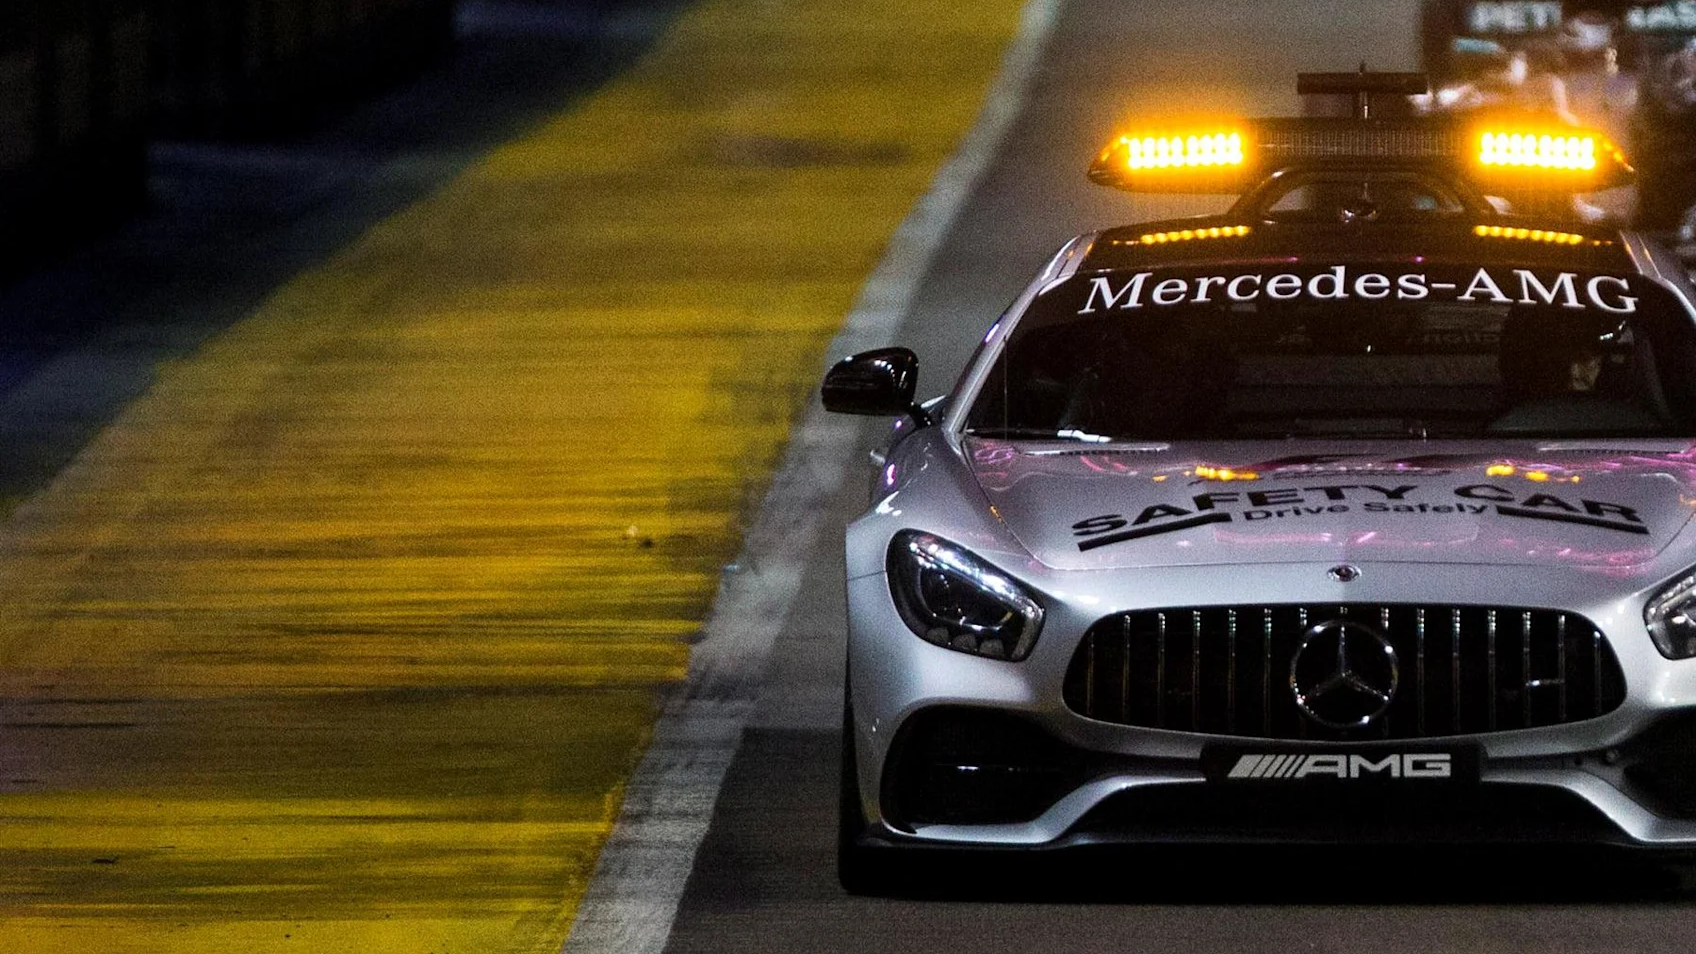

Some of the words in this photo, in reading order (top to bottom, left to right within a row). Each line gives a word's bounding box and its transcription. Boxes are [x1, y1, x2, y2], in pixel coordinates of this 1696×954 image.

[1077, 265, 1639, 315] Mercedes-AMG
[1071, 484, 1418, 537] SAFETY
[1454, 483, 1645, 523] CAR
[1244, 501, 1350, 522] Drive
[1363, 500, 1488, 516] Safely
[1294, 754, 1452, 779] AMG
